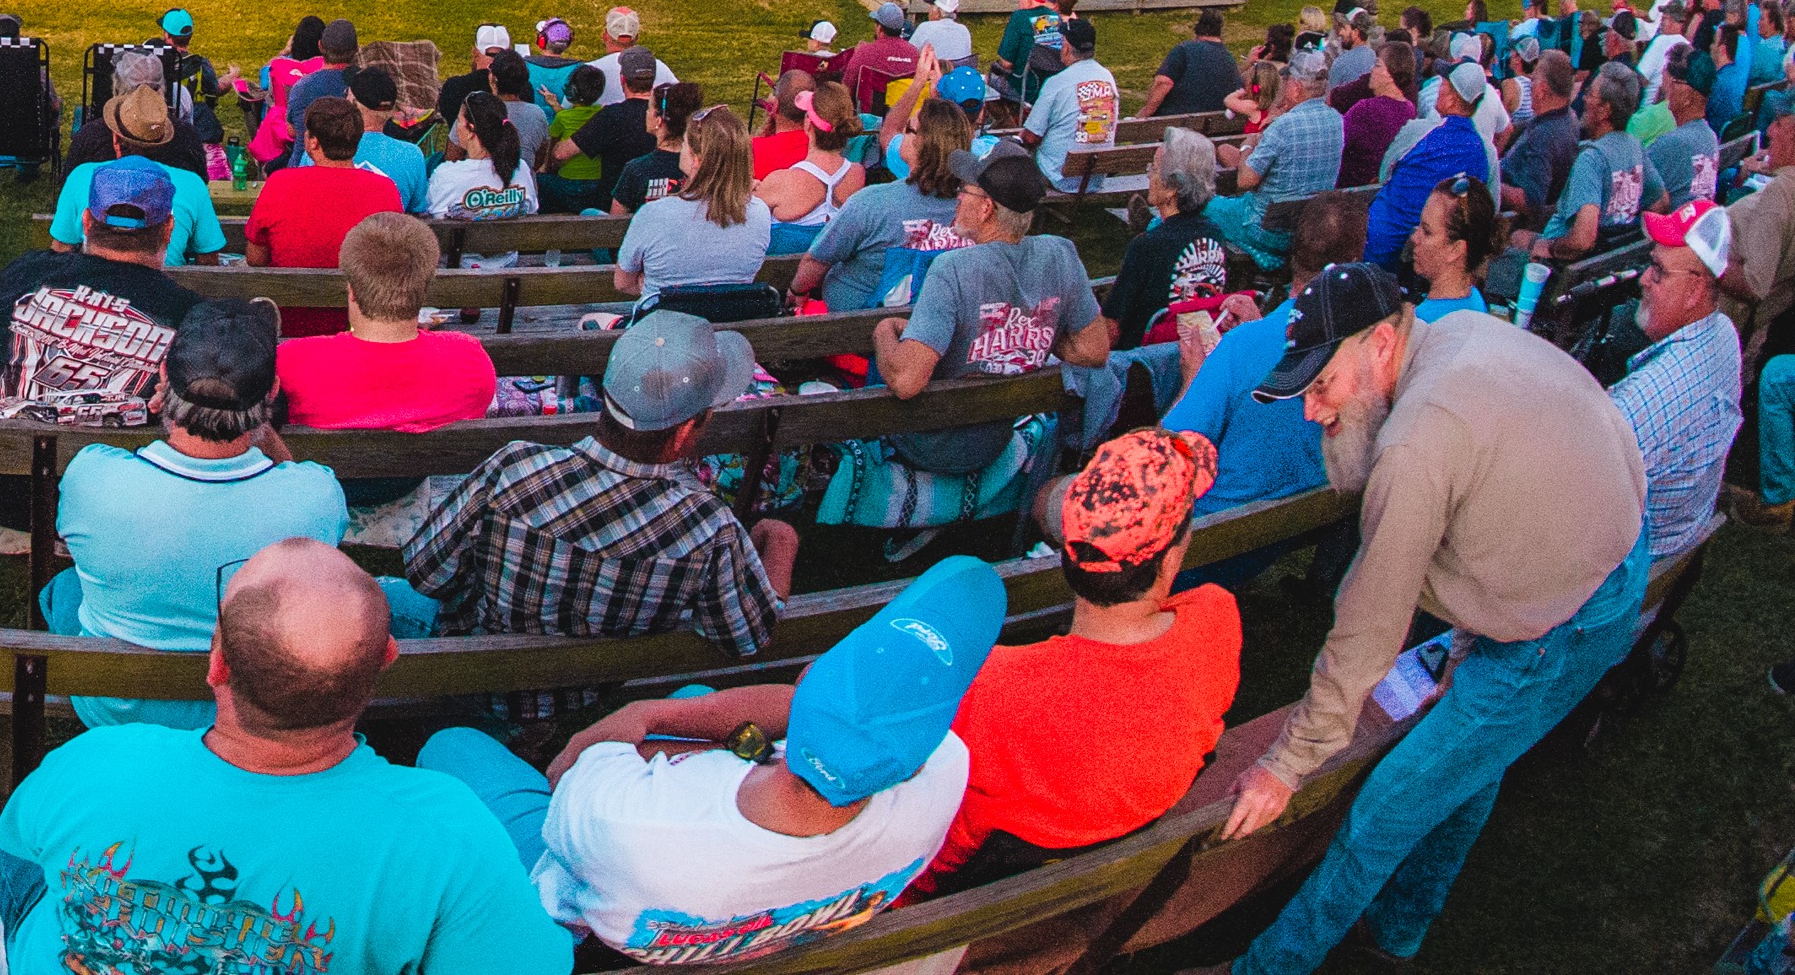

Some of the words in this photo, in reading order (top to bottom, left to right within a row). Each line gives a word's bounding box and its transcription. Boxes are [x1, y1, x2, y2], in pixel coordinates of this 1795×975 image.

[465, 188, 524, 209] O'Reilly
[12, 286, 177, 364] JACKSON
[1005, 307, 1038, 330] Rex
[39, 357, 109, 391] 65
[658, 922, 737, 947] LUCAS
